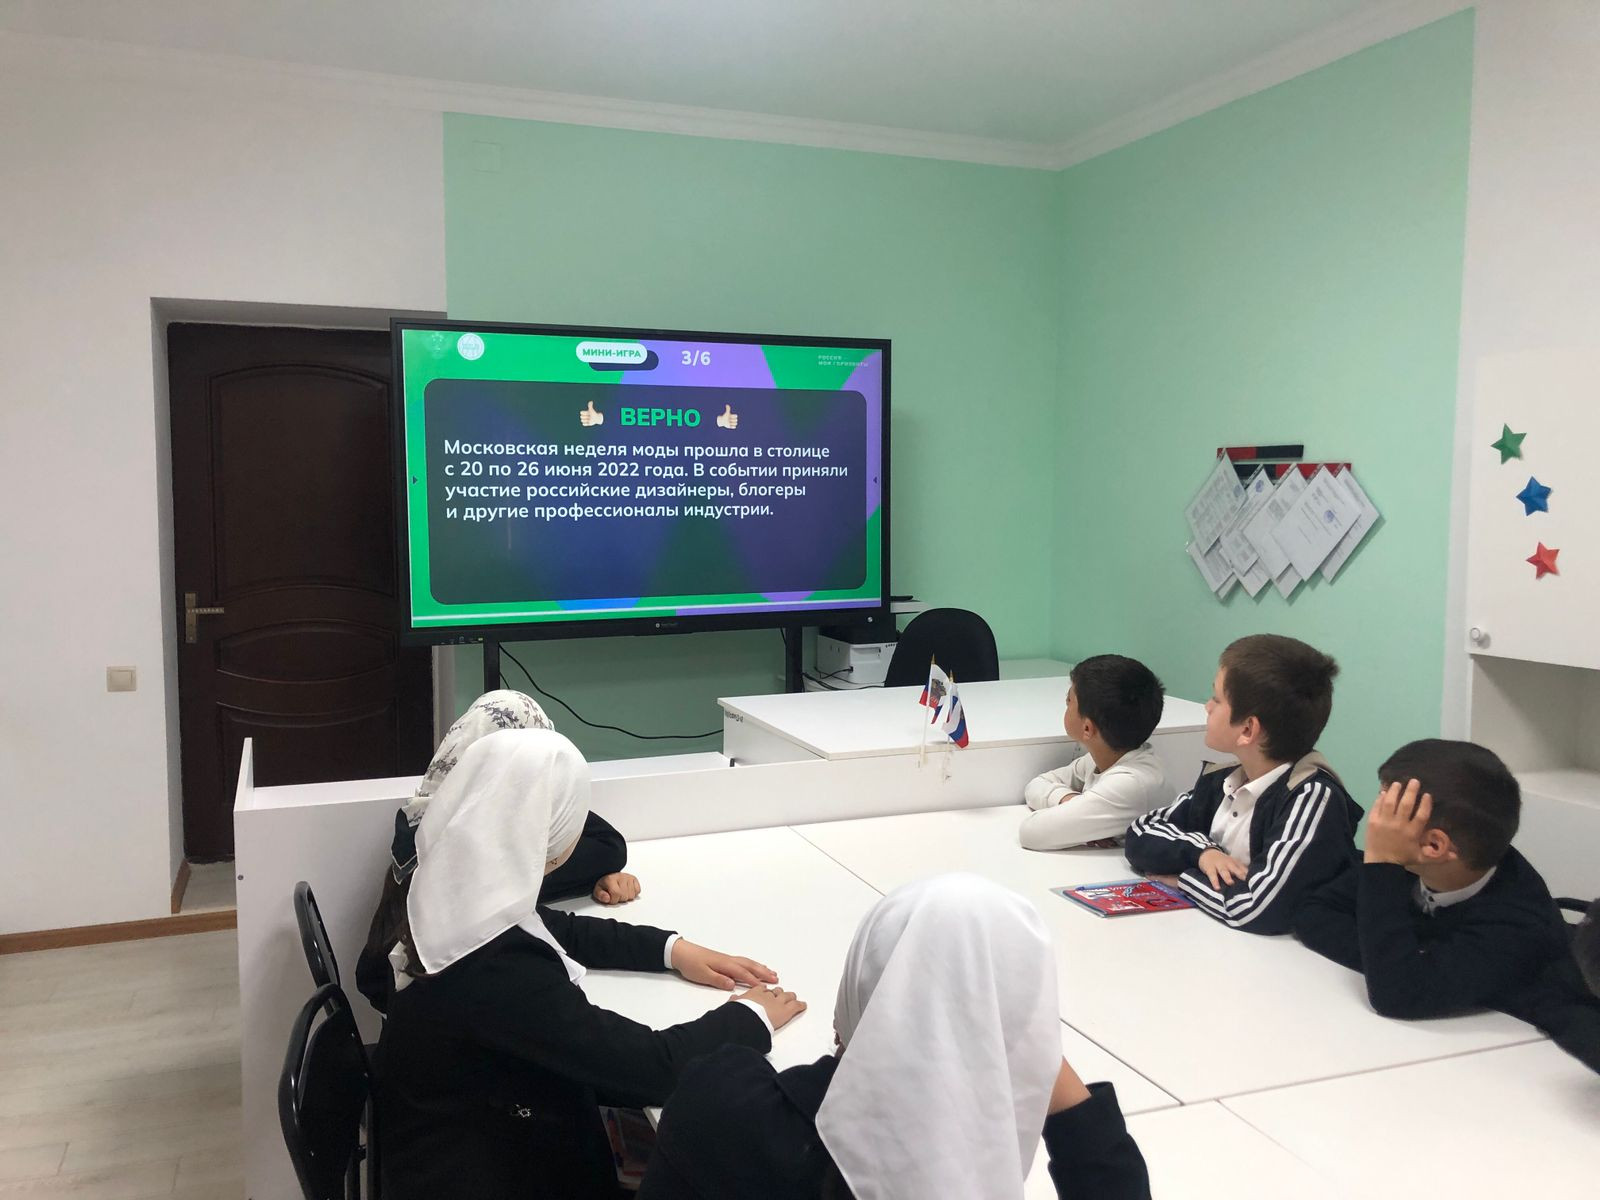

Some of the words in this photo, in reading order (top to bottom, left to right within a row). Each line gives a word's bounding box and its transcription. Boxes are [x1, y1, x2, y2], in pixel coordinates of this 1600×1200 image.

[582, 348, 642, 358] МИНИ-ИГРА
[681, 350, 711, 367] 3/6
[620, 407, 701, 427] ВЕРНО
[444, 440, 558, 455] Московская
[564, 444, 627, 457] неделя
[632, 445, 679, 458] моды
[684, 445, 749, 460] прошла
[754, 446, 763, 457] в
[767, 446, 830, 459] столице
[445, 464, 454, 476] с
[460, 461, 483, 476] 20
[489, 464, 512, 476] по
[517, 461, 539, 476] 26
[544, 464, 592, 476] июня
[597, 462, 640, 477] 2022
[644, 465, 688, 478] года.
[693, 463, 705, 477] В
[709, 462, 778, 477] событии
[782, 466, 848, 480] приняли
[445, 485, 521, 501] участие
[526, 483, 630, 500] российские
[635, 483, 734, 500] дизайнеры,
[738, 483, 806, 499] блогеры
[446, 507, 458, 518] и
[463, 507, 529, 522] другие
[534, 502, 679, 521] профессионалы
[684, 505, 774, 519] индустрии.
